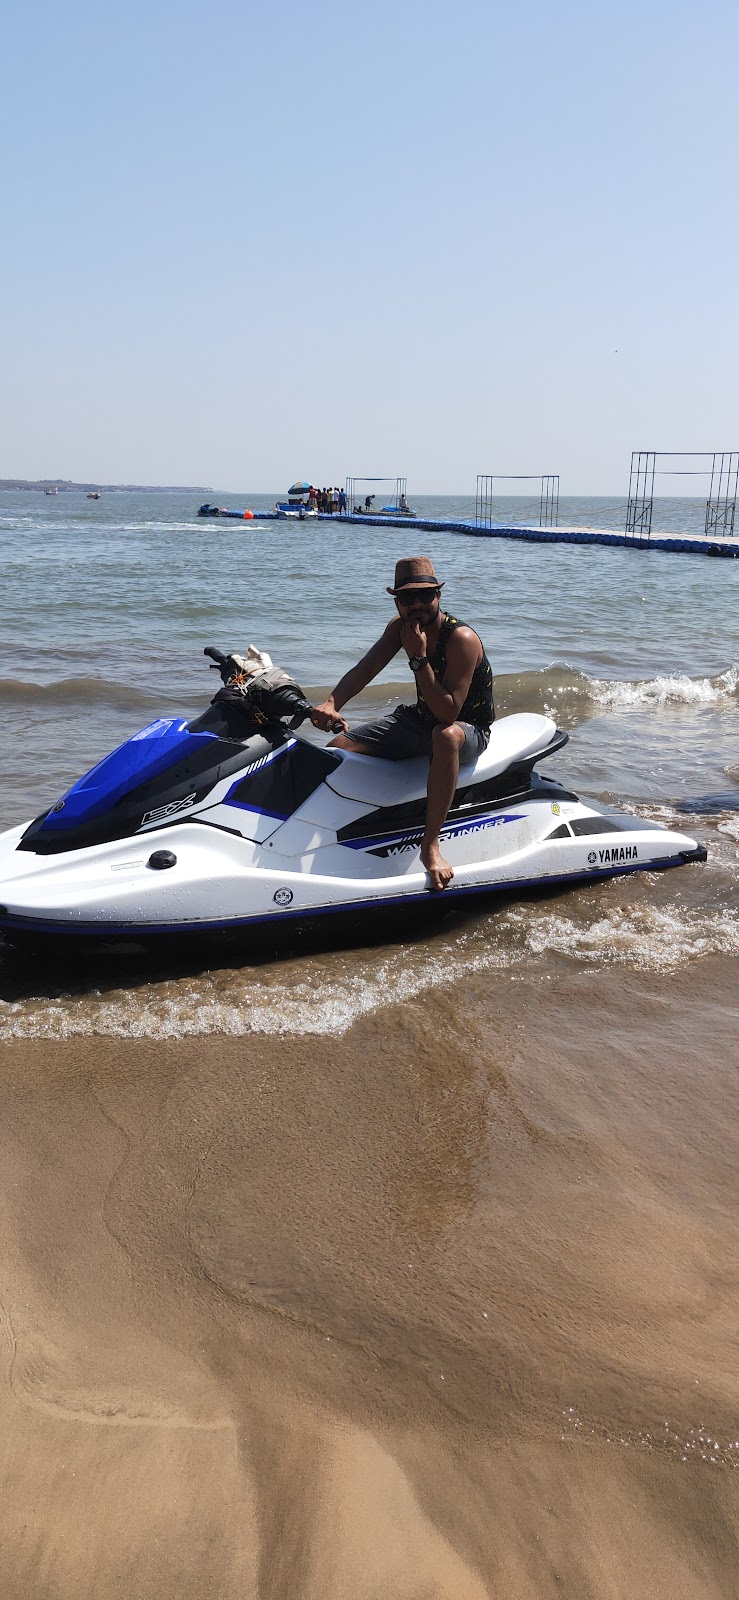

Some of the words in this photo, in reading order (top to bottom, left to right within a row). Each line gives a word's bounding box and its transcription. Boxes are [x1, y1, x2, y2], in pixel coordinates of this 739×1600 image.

[141, 792, 197, 825] EX
[386, 817, 506, 857] WAVRUNNER
[598, 845, 638, 863] YAMAHA
